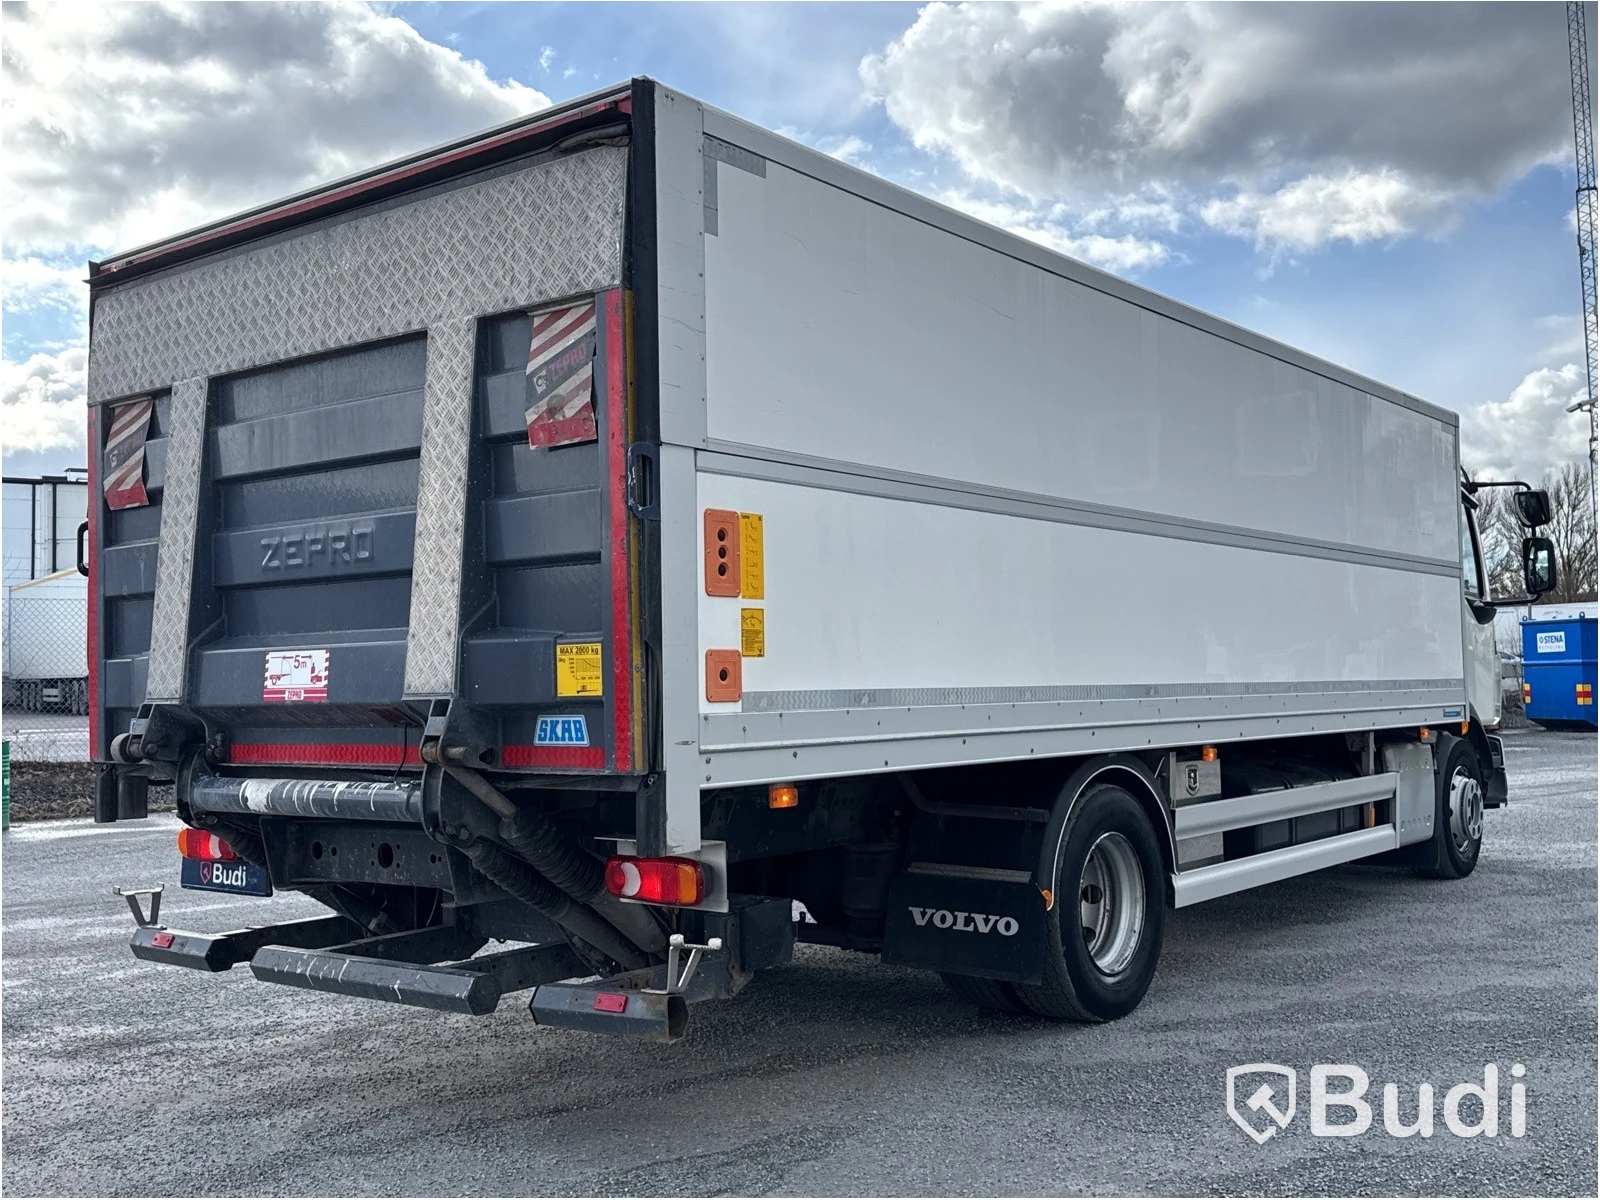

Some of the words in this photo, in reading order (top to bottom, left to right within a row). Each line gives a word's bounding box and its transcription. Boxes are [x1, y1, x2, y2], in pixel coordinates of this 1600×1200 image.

[548, 344, 587, 380] ZEPRO
[260, 526, 375, 571] ZEPRO
[1544, 634, 1564, 644] STENA
[559, 647, 574, 655] MAX
[575, 646, 589, 655] 2000
[591, 646, 599, 656] kg
[287, 690, 302, 700] ZEPRO
[537, 719, 586, 742] SKAB
[212, 863, 247, 887] Budi
[908, 906, 1020, 936] VOLVO
